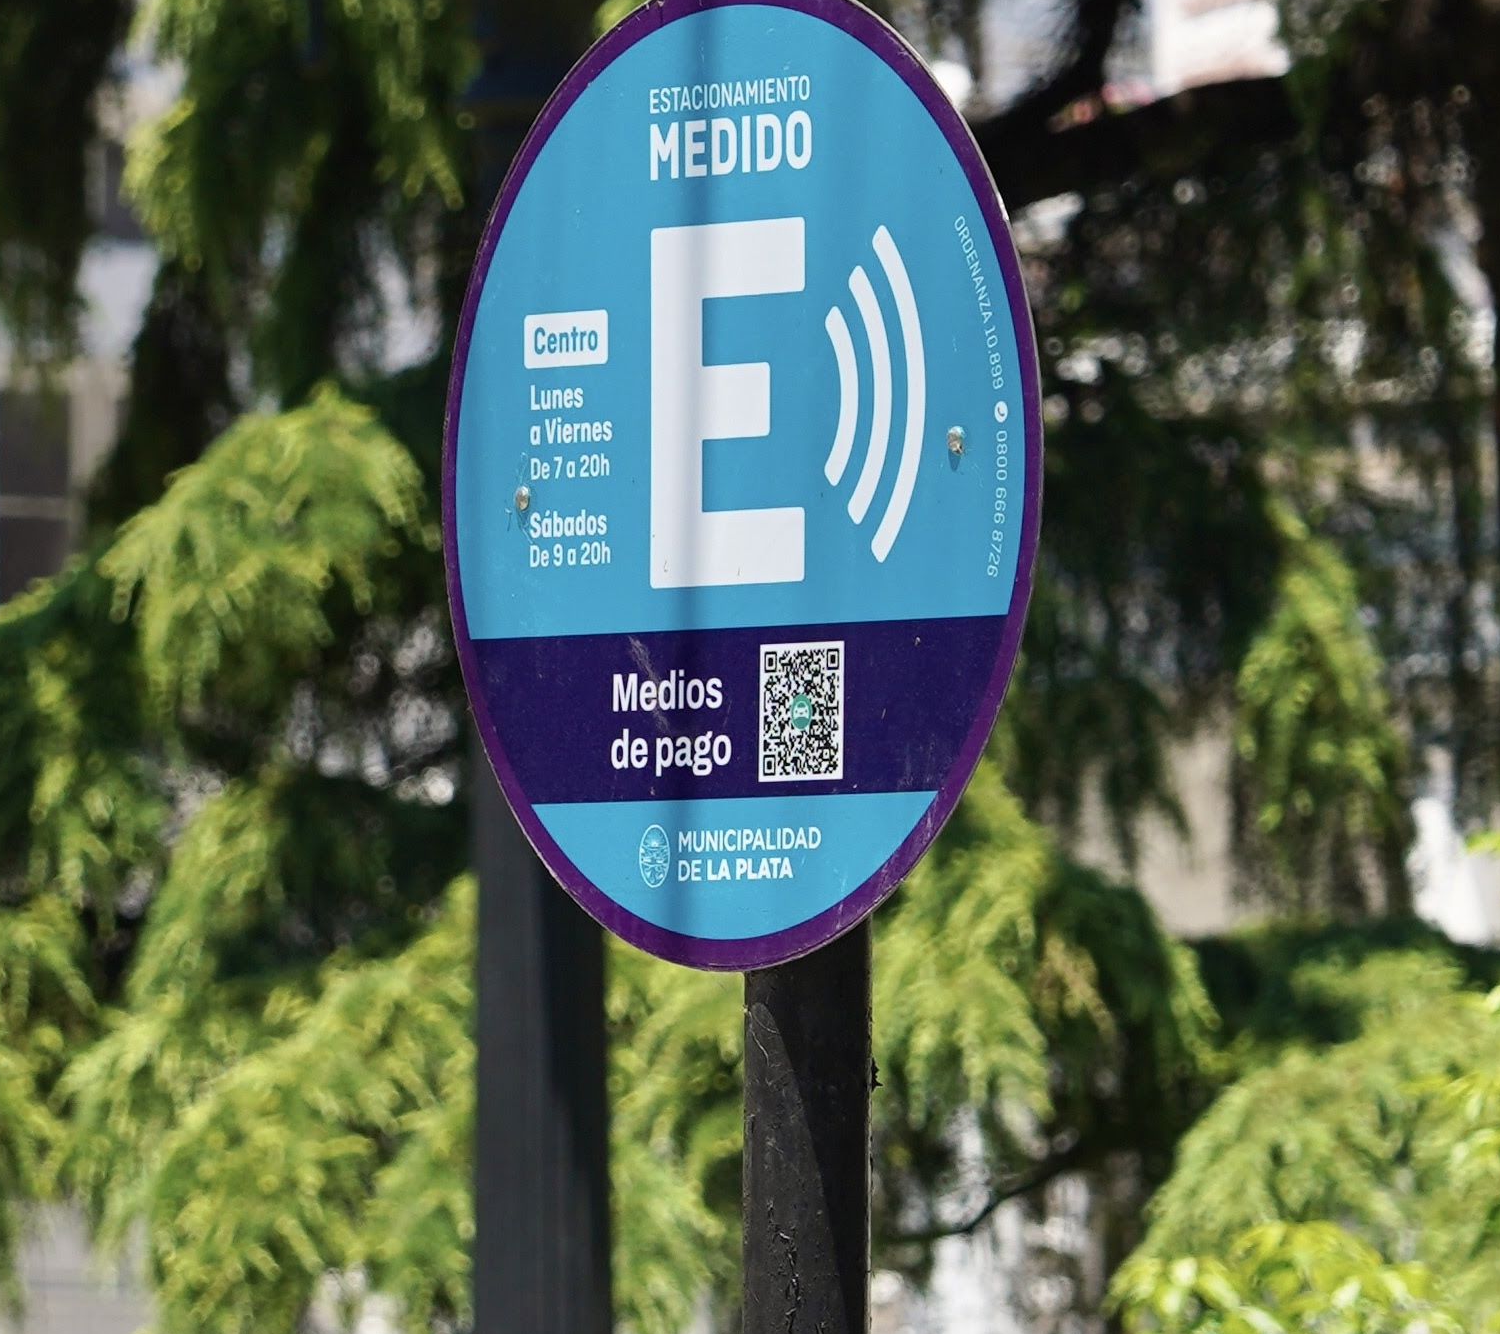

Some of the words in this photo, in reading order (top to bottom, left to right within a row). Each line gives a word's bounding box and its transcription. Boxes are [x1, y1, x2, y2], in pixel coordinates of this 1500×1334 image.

[650, 75, 810, 114] ESTACIONAMIENTO
[650, 110, 812, 181] MEDIDO
[954, 215, 993, 324] ORDENANZA
[983, 324, 1004, 390] 10.899
[533, 326, 598, 355] Centro
[530, 385, 583, 410] Lunes
[650, 217, 805, 589] E
[530, 424, 541, 445] a
[544, 417, 613, 444] Viernes
[530, 458, 550, 480] De
[553, 456, 563, 479] 7
[566, 460, 576, 478] a
[579, 453, 610, 477] 20h
[996, 430, 1008, 481] 0800
[993, 487, 1007, 524] 666
[529, 510, 607, 539] Sábados
[529, 545, 549, 567] De
[553, 543, 563, 566] 9
[567, 548, 576, 565] a
[580, 541, 611, 565] 20h
[986, 529, 1004, 578] 8726
[612, 669, 723, 713] Medios
[610, 728, 648, 769] de
[655, 730, 732, 777] pago
[678, 826, 822, 853] MUNICIPALIDAD
[677, 859, 702, 882] DE
[706, 859, 731, 881] LA
[735, 857, 794, 880] PLATA
